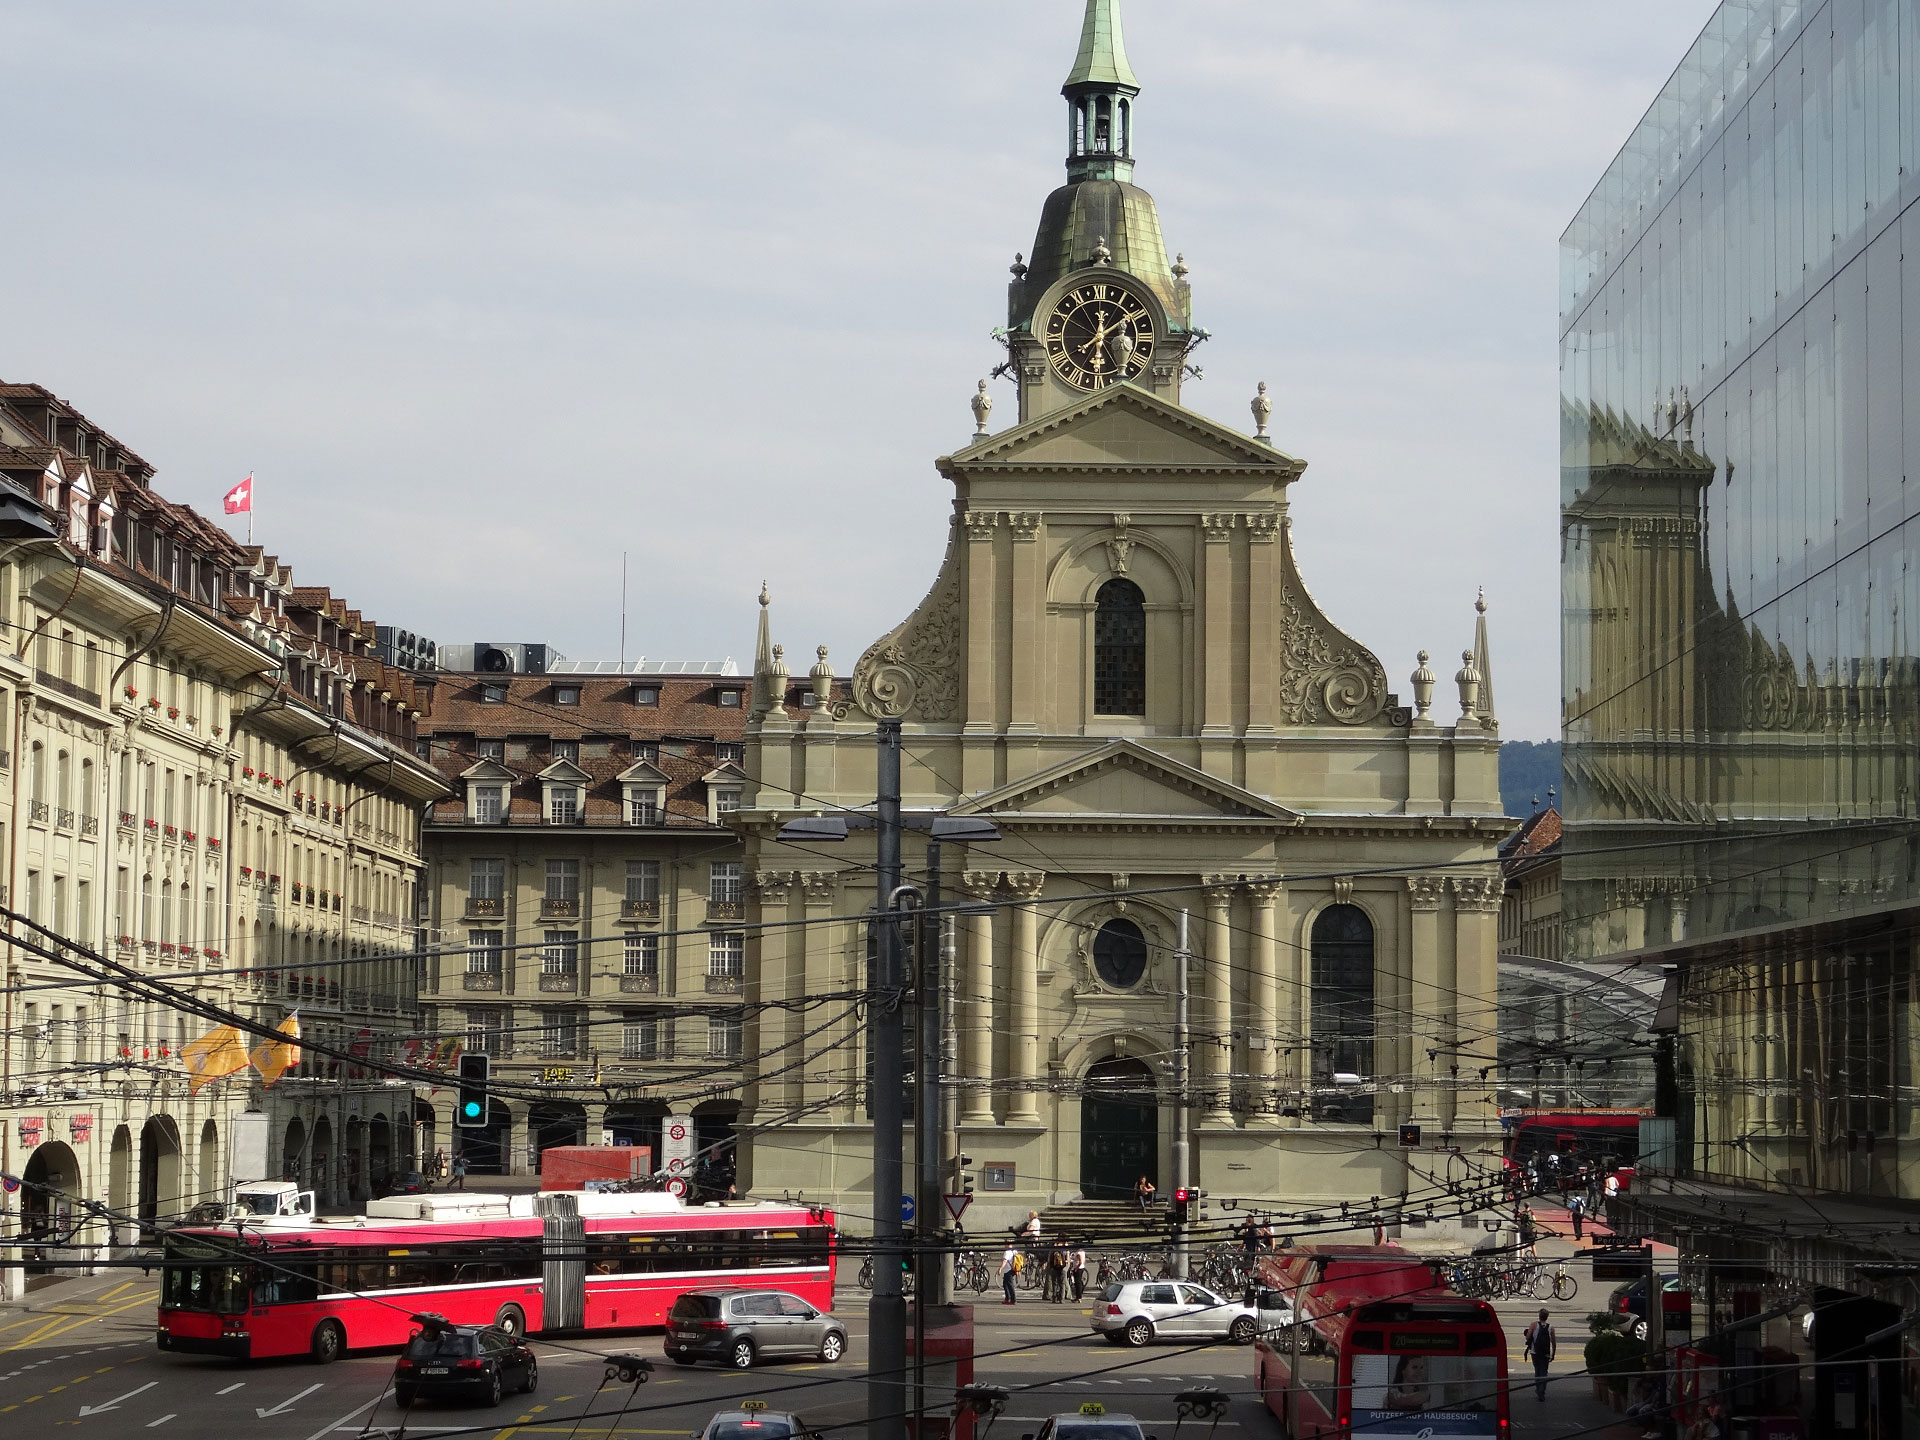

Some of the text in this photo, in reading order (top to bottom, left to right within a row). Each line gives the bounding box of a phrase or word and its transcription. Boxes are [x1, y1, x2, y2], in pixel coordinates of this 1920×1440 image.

[1069, 289, 1085, 306] XI
[1093, 285, 1106, 300] XII
[1053, 307, 1068, 321] X
[1046, 331, 1062, 341] IX
[1138, 332, 1153, 343] III
[1068, 367, 1084, 385] VII
[1424, 1412, 1478, 1420] HAUSBESUCH
